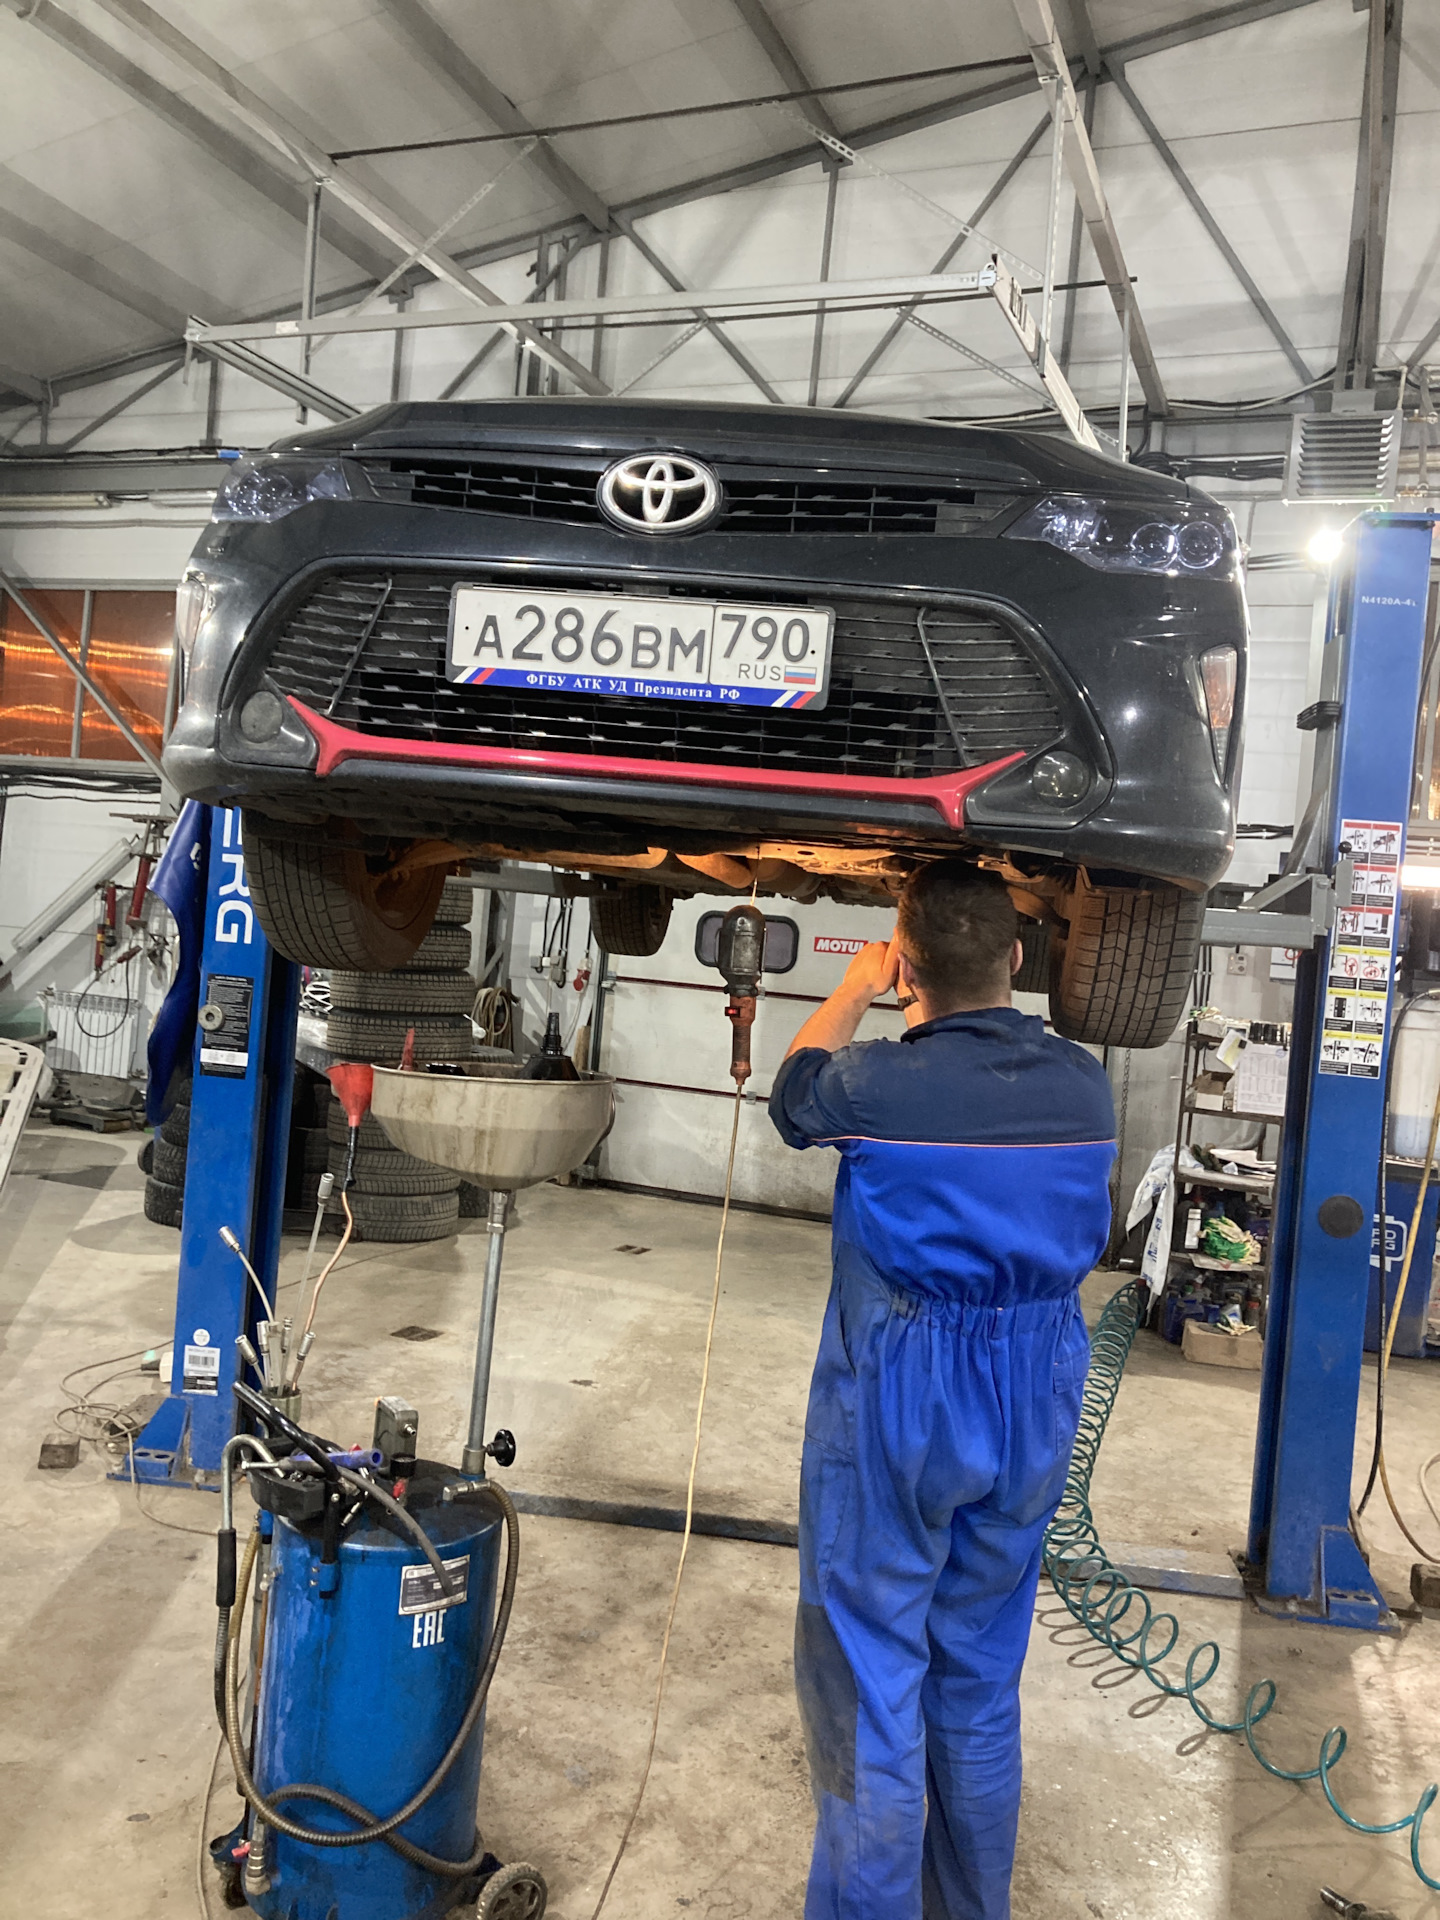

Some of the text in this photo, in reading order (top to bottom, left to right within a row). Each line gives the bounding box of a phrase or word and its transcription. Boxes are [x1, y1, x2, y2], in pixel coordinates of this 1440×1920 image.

[721, 613, 810, 662] 790
[526, 673, 741, 700] ФГБУ АТК УД Президента РФ
[738, 663, 782, 682] RUS
[412, 1609, 447, 1648] EAC
